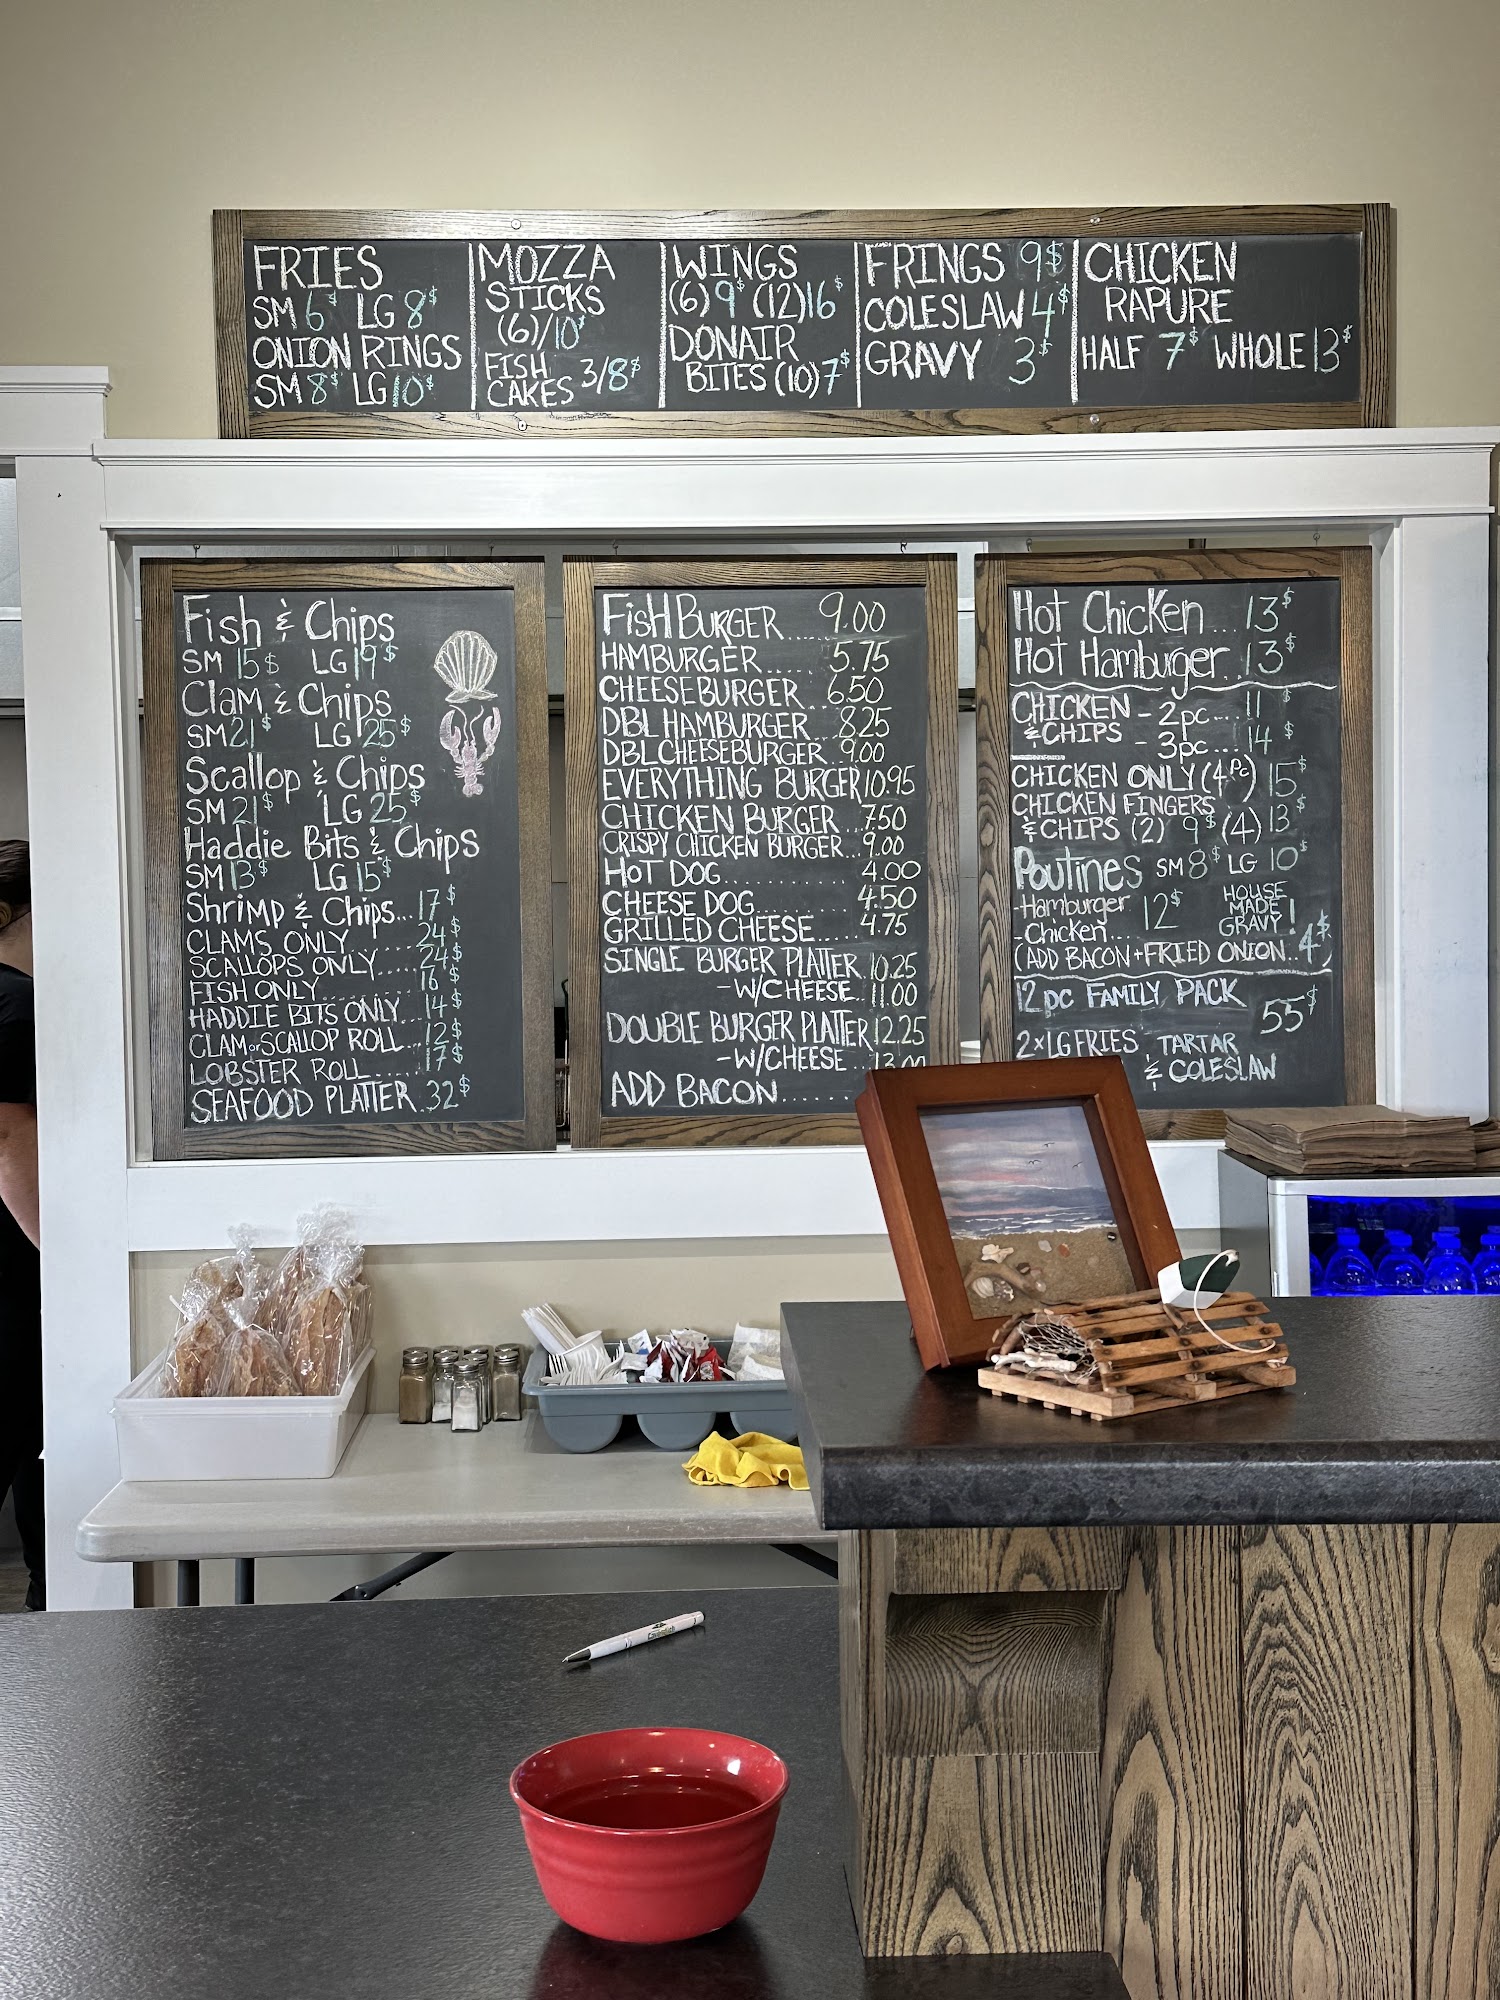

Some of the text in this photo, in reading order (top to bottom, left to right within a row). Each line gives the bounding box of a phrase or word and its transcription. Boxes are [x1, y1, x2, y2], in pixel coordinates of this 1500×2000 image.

[253, 244, 383, 290] FRIES
[478, 243, 615, 284] MOZZA
[673, 243, 798, 280] WINGS
[864, 242, 1006, 288] FRINGS
[1085, 240, 1238, 284] CHICKEN
[253, 293, 395, 329] SM LG
[486, 282, 606, 315] STICKS
[864, 290, 1024, 333] COLESLAW
[1105, 286, 1233, 324] RAPURE
[252, 333, 462, 370] ONION RINGS
[669, 324, 799, 362] DONAIR
[1081, 331, 1305, 371] HALF WHOLE
[485, 352, 548, 380] FISH
[865, 339, 982, 380] GRAVY
[255, 371, 387, 409] SM LG
[487, 376, 574, 407] CAKES
[686, 362, 767, 393] BITES
[182, 595, 262, 647] Fish
[305, 597, 394, 655] Chips
[676, 593, 785, 647] BURGER
[819, 591, 886, 633] 9.00
[1013, 588, 1203, 636] Hot Chicken
[183, 649, 347, 675] SM LG
[601, 641, 890, 673] HAMBURGER 5.75
[1014, 636, 1068, 675] Hot
[827, 673, 884, 704] 6.50
[299, 682, 391, 737] Chips
[602, 706, 892, 740] DBL HAMBURGER 8.25
[1012, 691, 1210, 740] CHICKEN 2pc
[187, 722, 351, 748] SM LG
[1041, 722, 1208, 764] CHIPS 3pc
[602, 739, 653, 766] DBL
[840, 738, 885, 763] 9.00
[186, 751, 301, 804] Scallop
[336, 754, 426, 796] Chips
[603, 765, 915, 804] EVERYTHING BURGER 10.95
[1011, 762, 1196, 791] CHICKEN ONLY
[186, 794, 363, 826] SM LG
[602, 803, 907, 835] CHICKEN BURGER 7.50
[1011, 792, 1216, 817] CHICKEN FINGERS
[602, 831, 904, 859] CRISPY CHICKEN BURGER 9.00
[1040, 818, 1120, 841] CHIPS
[184, 824, 291, 860] Haddie
[304, 825, 359, 860] Bits
[394, 824, 480, 874] Chips
[186, 862, 348, 891] SM LG
[670, 859, 721, 887] DOG
[862, 860, 921, 882] 4.00
[1014, 846, 1144, 893] Poutines
[1156, 858, 1183, 877] SM
[1228, 853, 1258, 874] LG
[602, 885, 917, 917] CHEESE DOG 4.50
[1223, 881, 1288, 901] HOUSE
[322, 897, 395, 939] Chips
[1229, 900, 1279, 915] MADE
[603, 913, 907, 943] GRILLED CHEESE 4.75
[1219, 914, 1283, 936] GRAVY
[187, 929, 349, 955] CLAMS ONLY
[1067, 947, 1130, 971] BACON
[1144, 941, 1211, 967] FRIED
[1217, 941, 1285, 963] ONION
[191, 949, 377, 981] SCALLOPS ONLY
[603, 946, 918, 981] SINGLE BURGER PLATTER 10.25
[191, 976, 319, 1005] FISH ONLY
[872, 982, 918, 1008] 11.00
[1087, 981, 1160, 1008] FAMILY
[1175, 978, 1247, 1007] PACK
[189, 997, 400, 1030] HADDIE BITS ONLY
[189, 1027, 404, 1058] CLAM or SCALLOP ROLL
[606, 1010, 926, 1051] DOUBLE BURGER PLATTER 12.25
[1047, 1031, 1072, 1058] LG
[1075, 1029, 1139, 1056] FRIES
[1158, 1033, 1239, 1055] TARTAR
[190, 1057, 371, 1087] LOBSTER ROLL
[1168, 1052, 1276, 1082] COLESLAW
[191, 1080, 417, 1124] SEAFOOD PLATTER
[611, 1070, 778, 1108] ADD BACON
